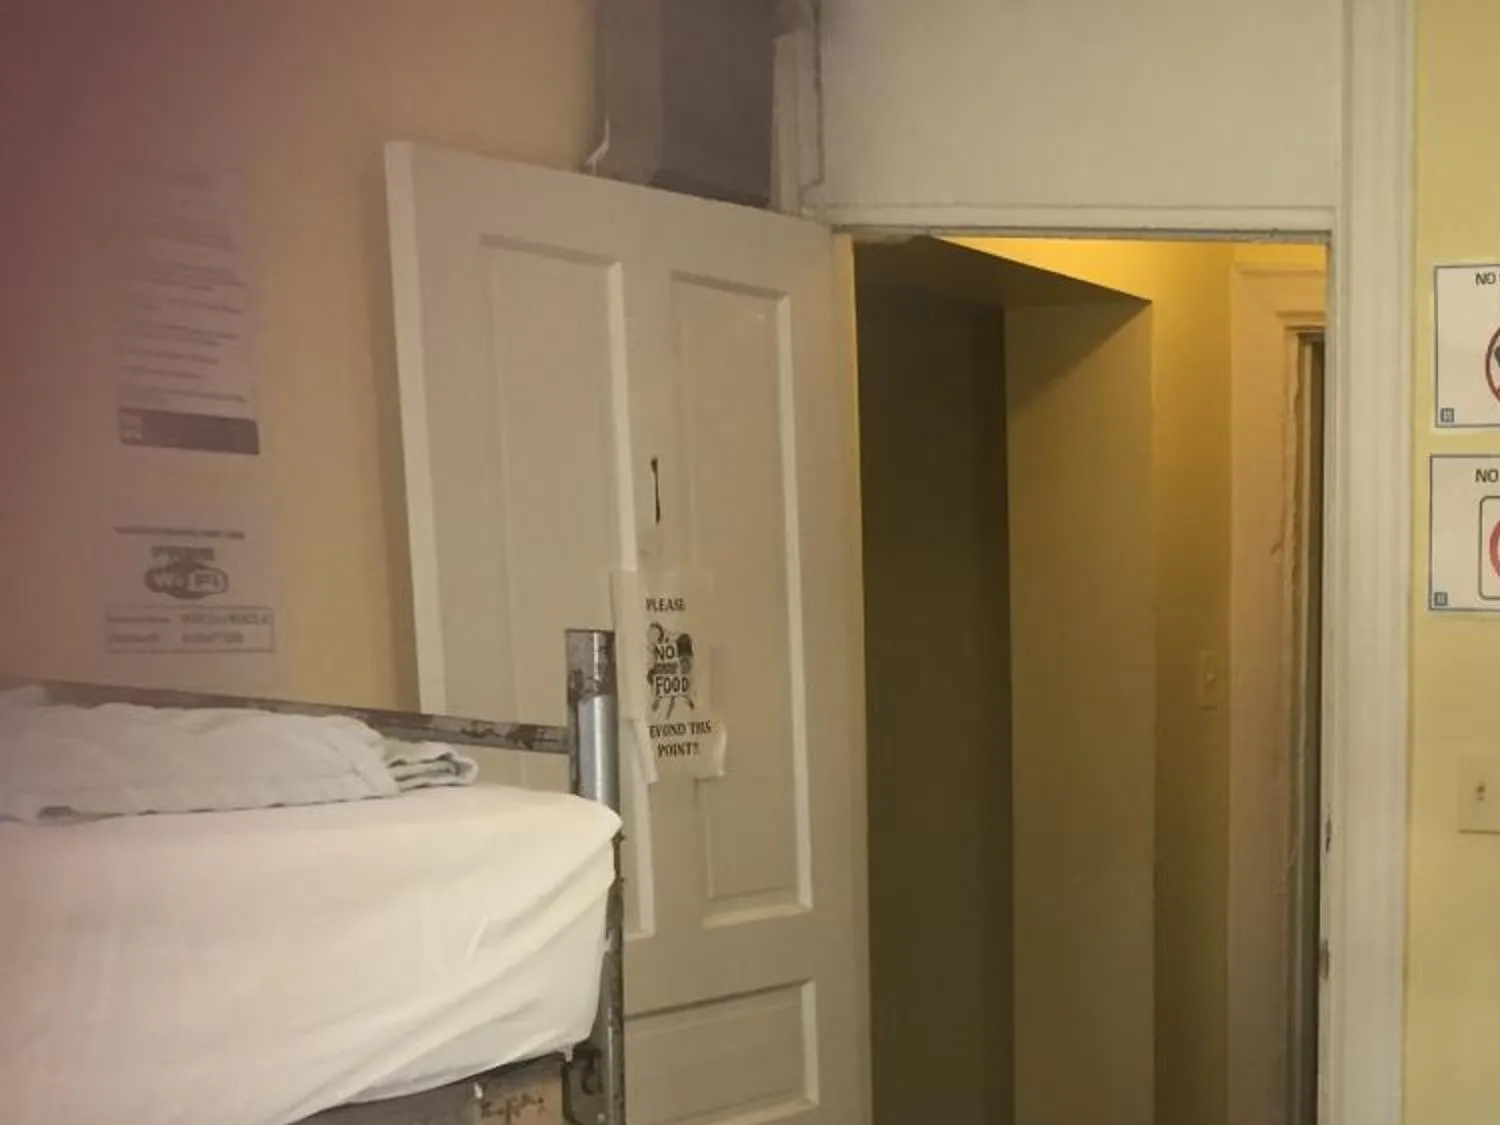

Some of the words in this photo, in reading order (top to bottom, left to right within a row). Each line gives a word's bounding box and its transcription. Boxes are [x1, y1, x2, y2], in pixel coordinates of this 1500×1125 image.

[1475, 271, 1497, 286] NO
[1475, 468, 1499, 483] NO
[655, 645, 675, 660] NO
[655, 676, 689, 696] FOOD
